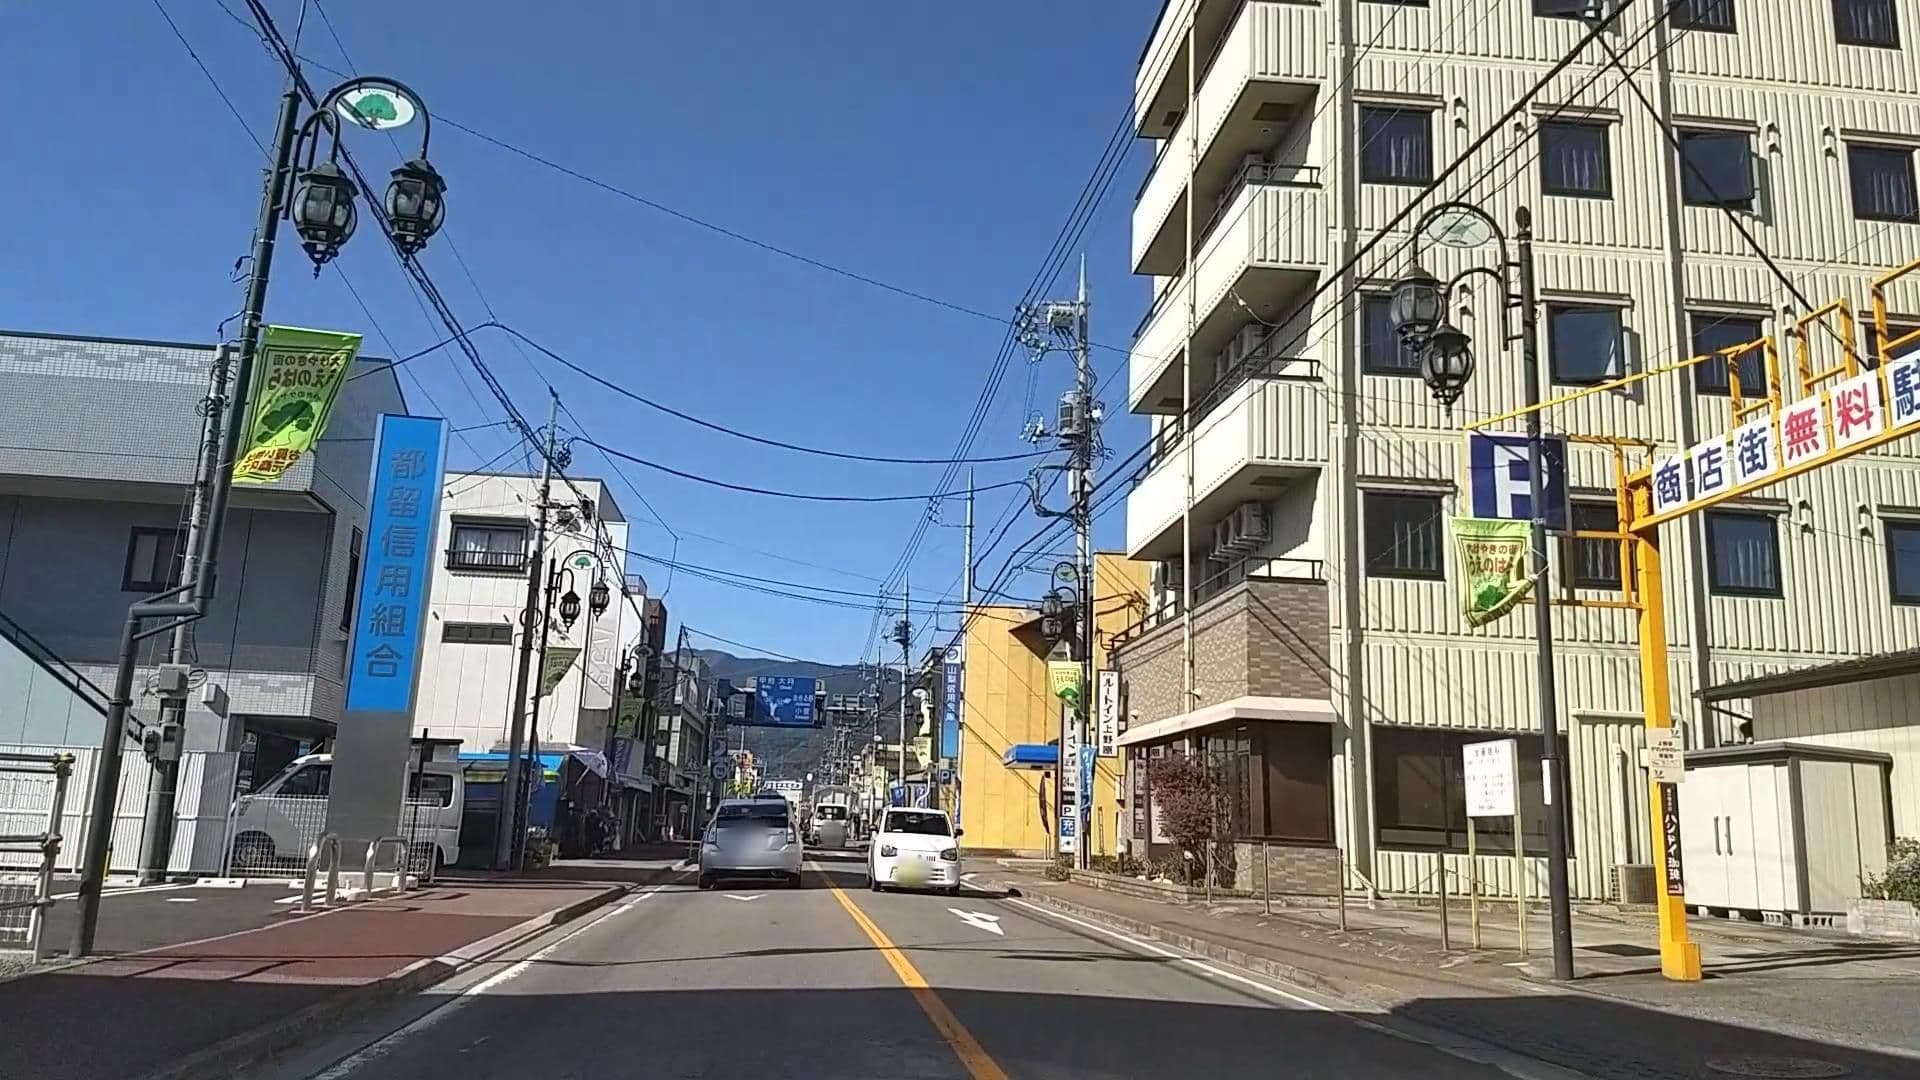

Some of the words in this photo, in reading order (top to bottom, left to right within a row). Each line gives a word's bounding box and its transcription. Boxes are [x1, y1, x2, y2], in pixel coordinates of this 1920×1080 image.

[1494, 444, 1551, 518] P
[366, 448, 427, 678] 都留信用組合
[1103, 678, 1114, 755] ルートイン上野原
[1064, 807, 1072, 815] P
